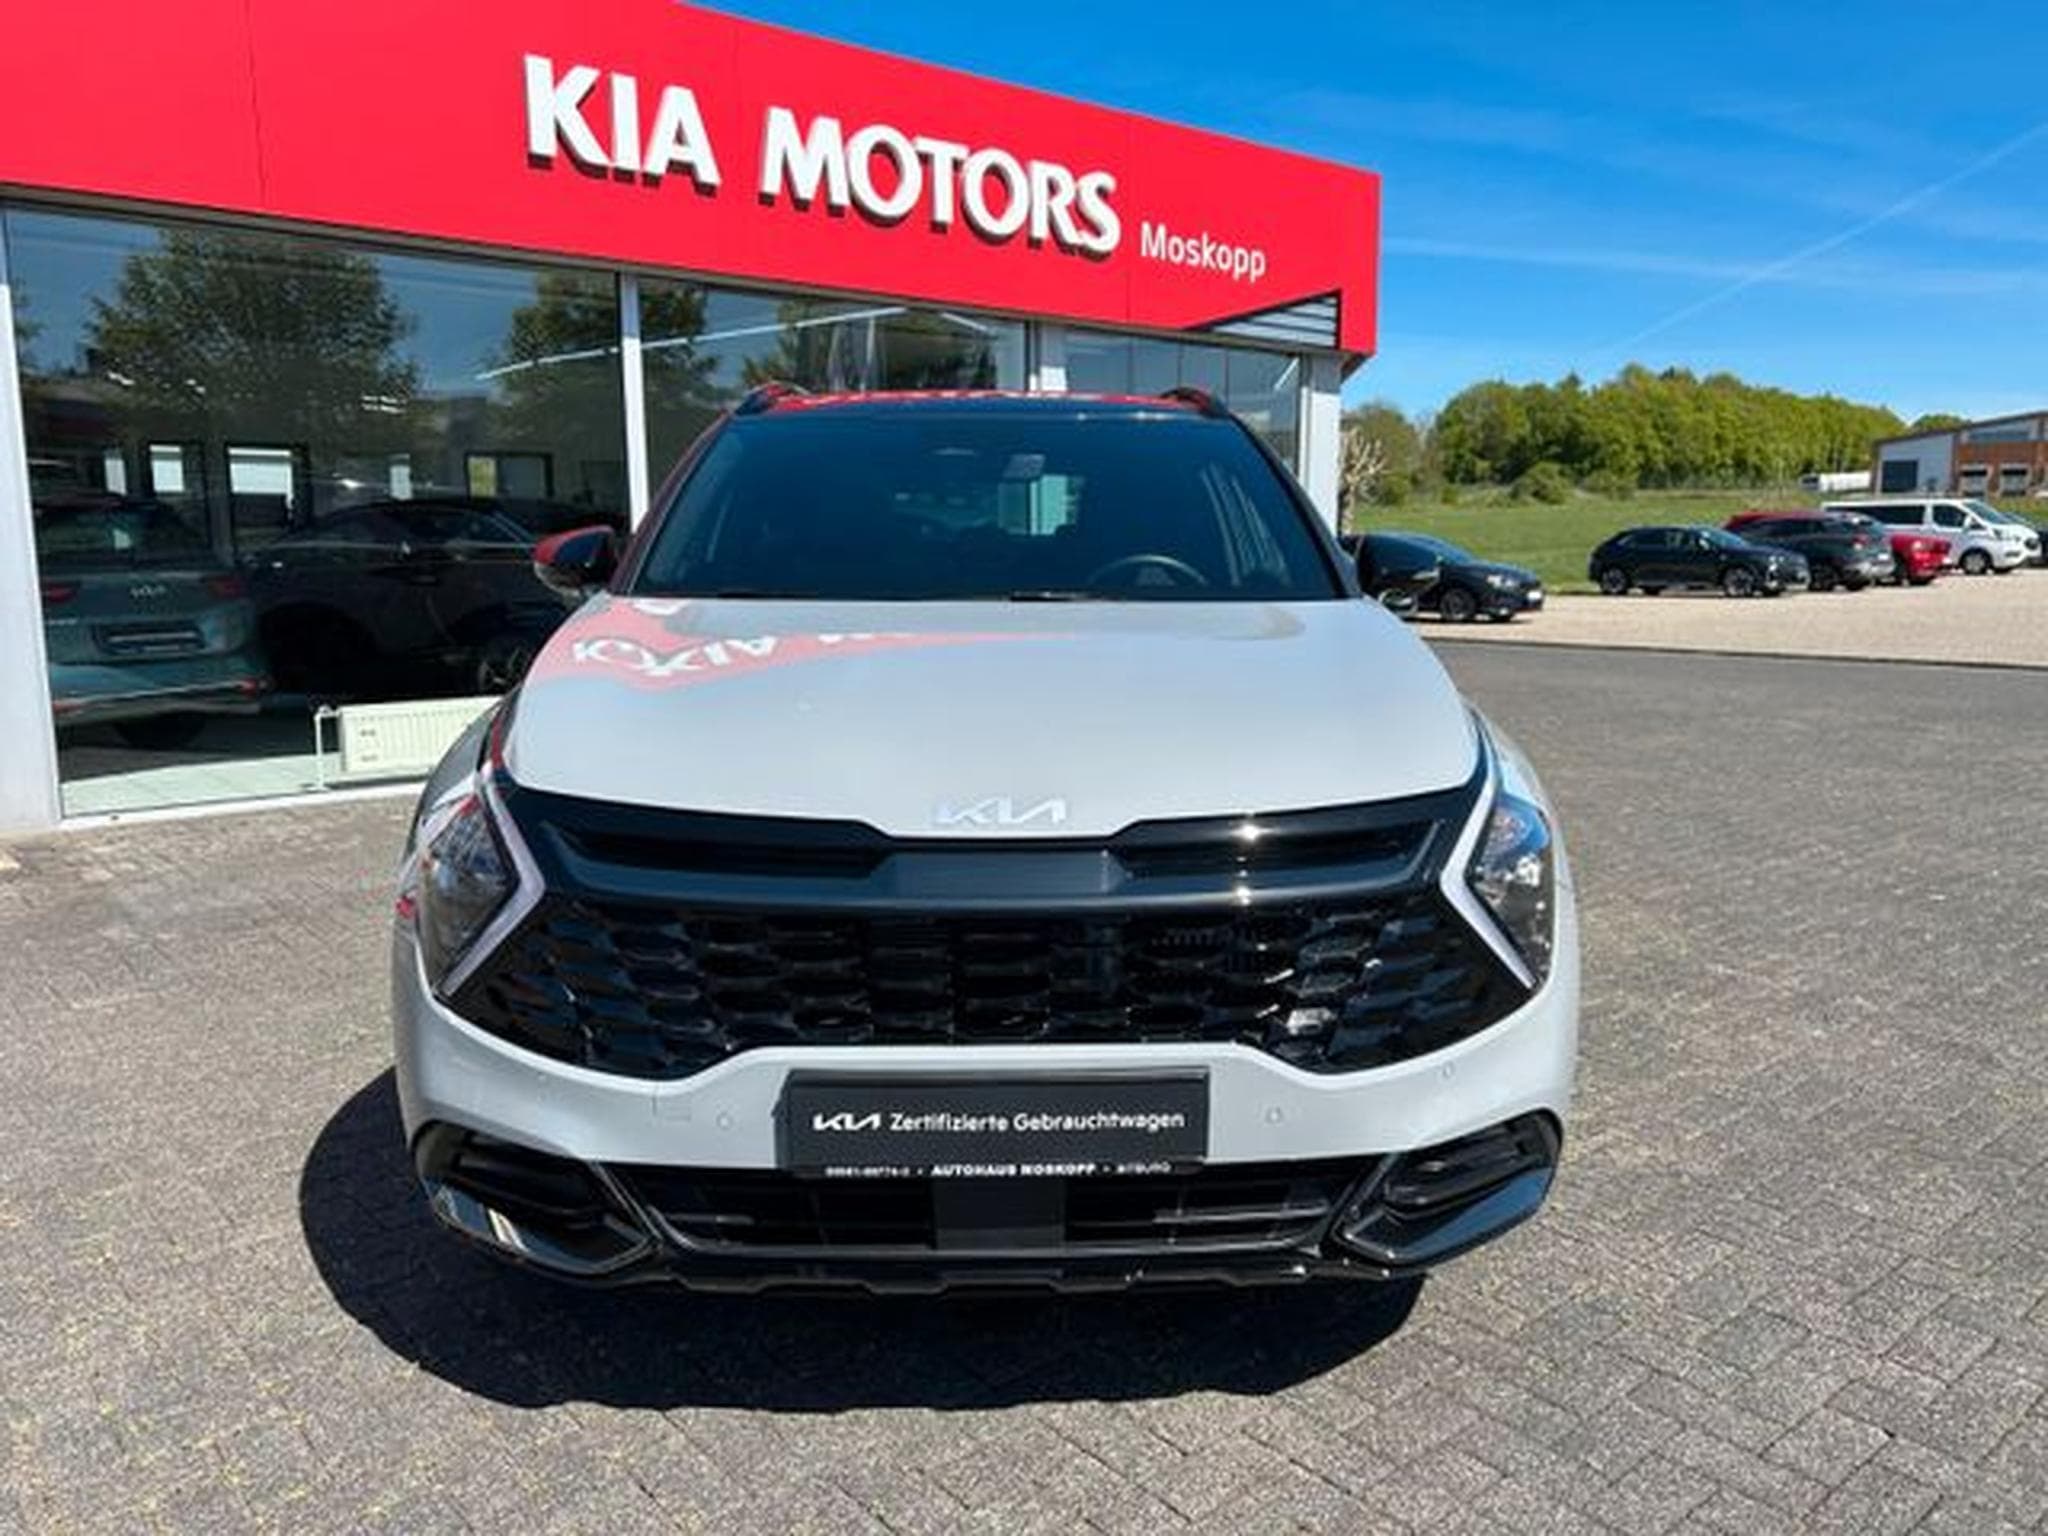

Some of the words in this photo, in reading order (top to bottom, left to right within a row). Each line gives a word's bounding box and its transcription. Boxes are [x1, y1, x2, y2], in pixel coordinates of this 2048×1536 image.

[524, 52, 722, 187] KIA
[759, 105, 1122, 254] MOTORS
[1140, 221, 1267, 283] Moskopp
[935, 797, 1067, 824] KIA
[813, 1112, 882, 1132] KIA
[889, 1111, 1009, 1132] Zertifizierte
[1012, 1110, 1186, 1134] Gebrauchtwagen
[930, 1163, 1017, 1177] AUTOHAUS
